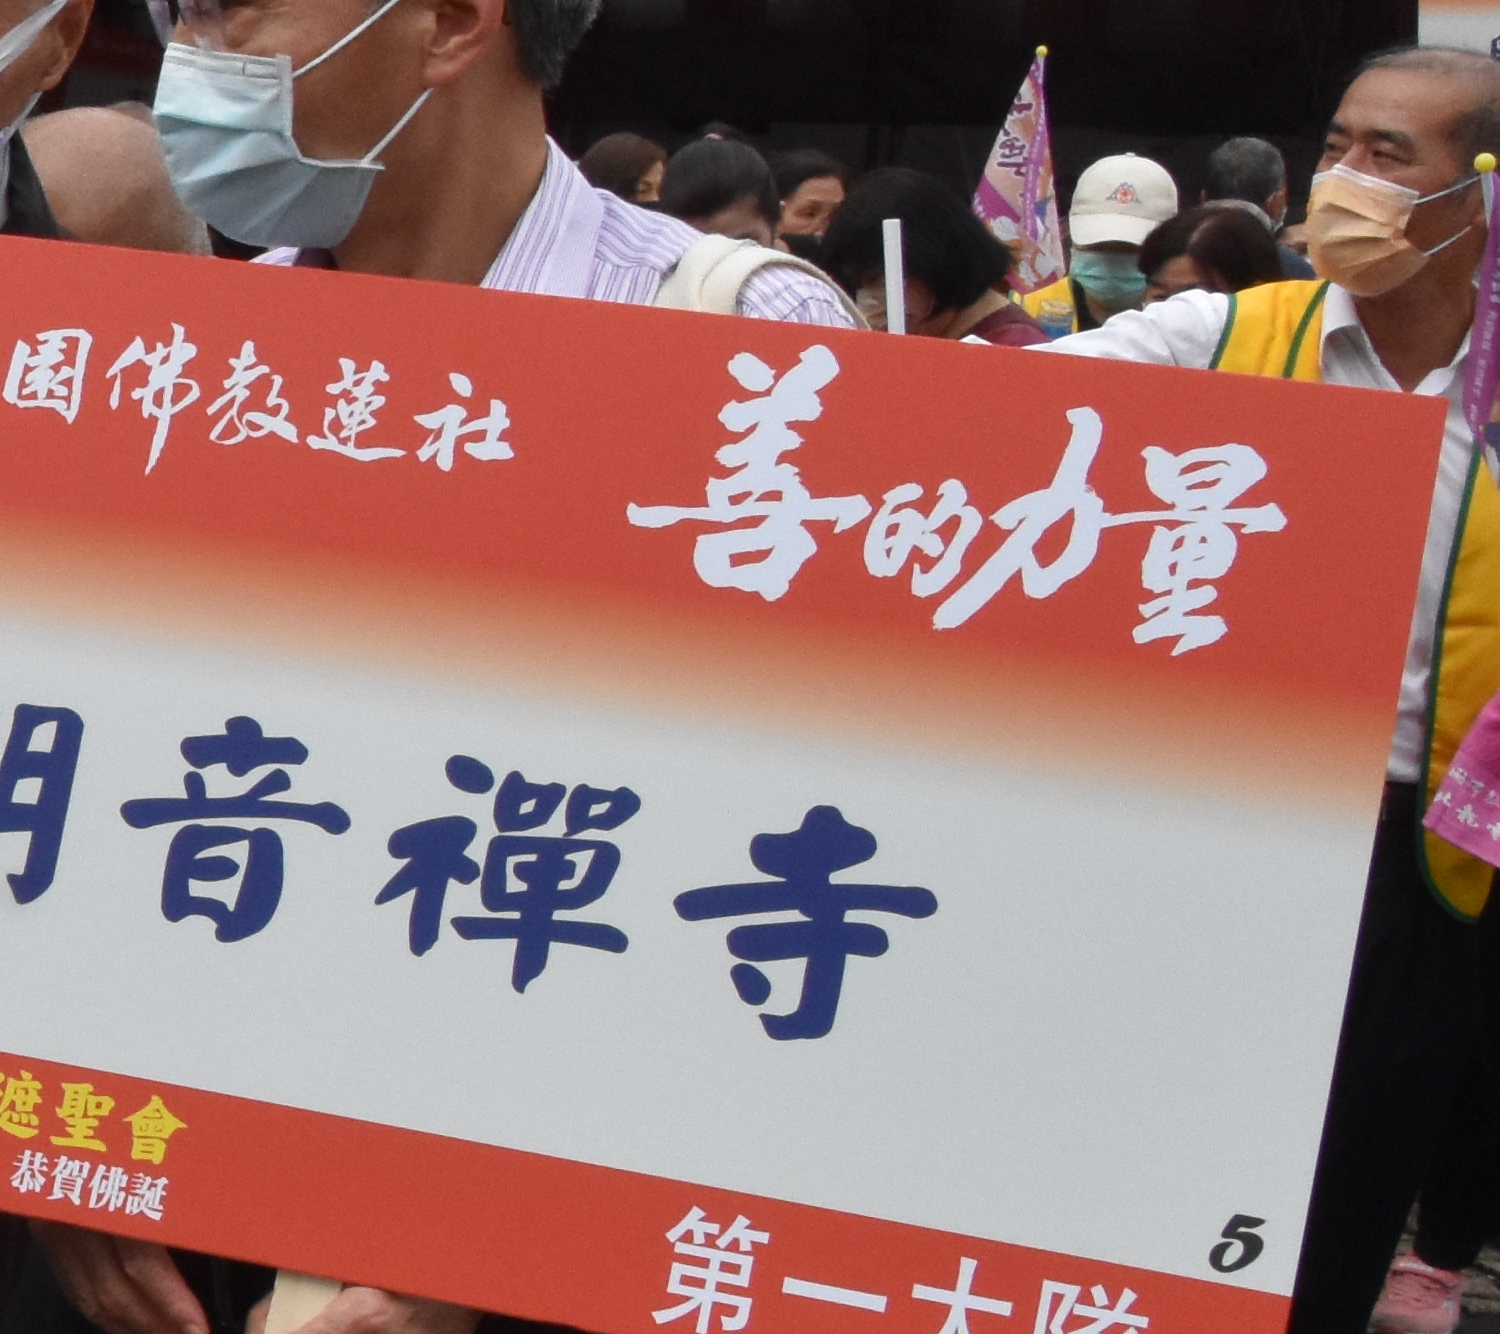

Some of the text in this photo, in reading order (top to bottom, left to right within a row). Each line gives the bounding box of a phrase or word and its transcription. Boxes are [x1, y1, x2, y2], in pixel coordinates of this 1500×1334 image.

[627, 349, 1290, 658] 善的力量
[8, 1150, 171, 1221] 恭賀佛誕
[1206, 1213, 1268, 1273] 5
